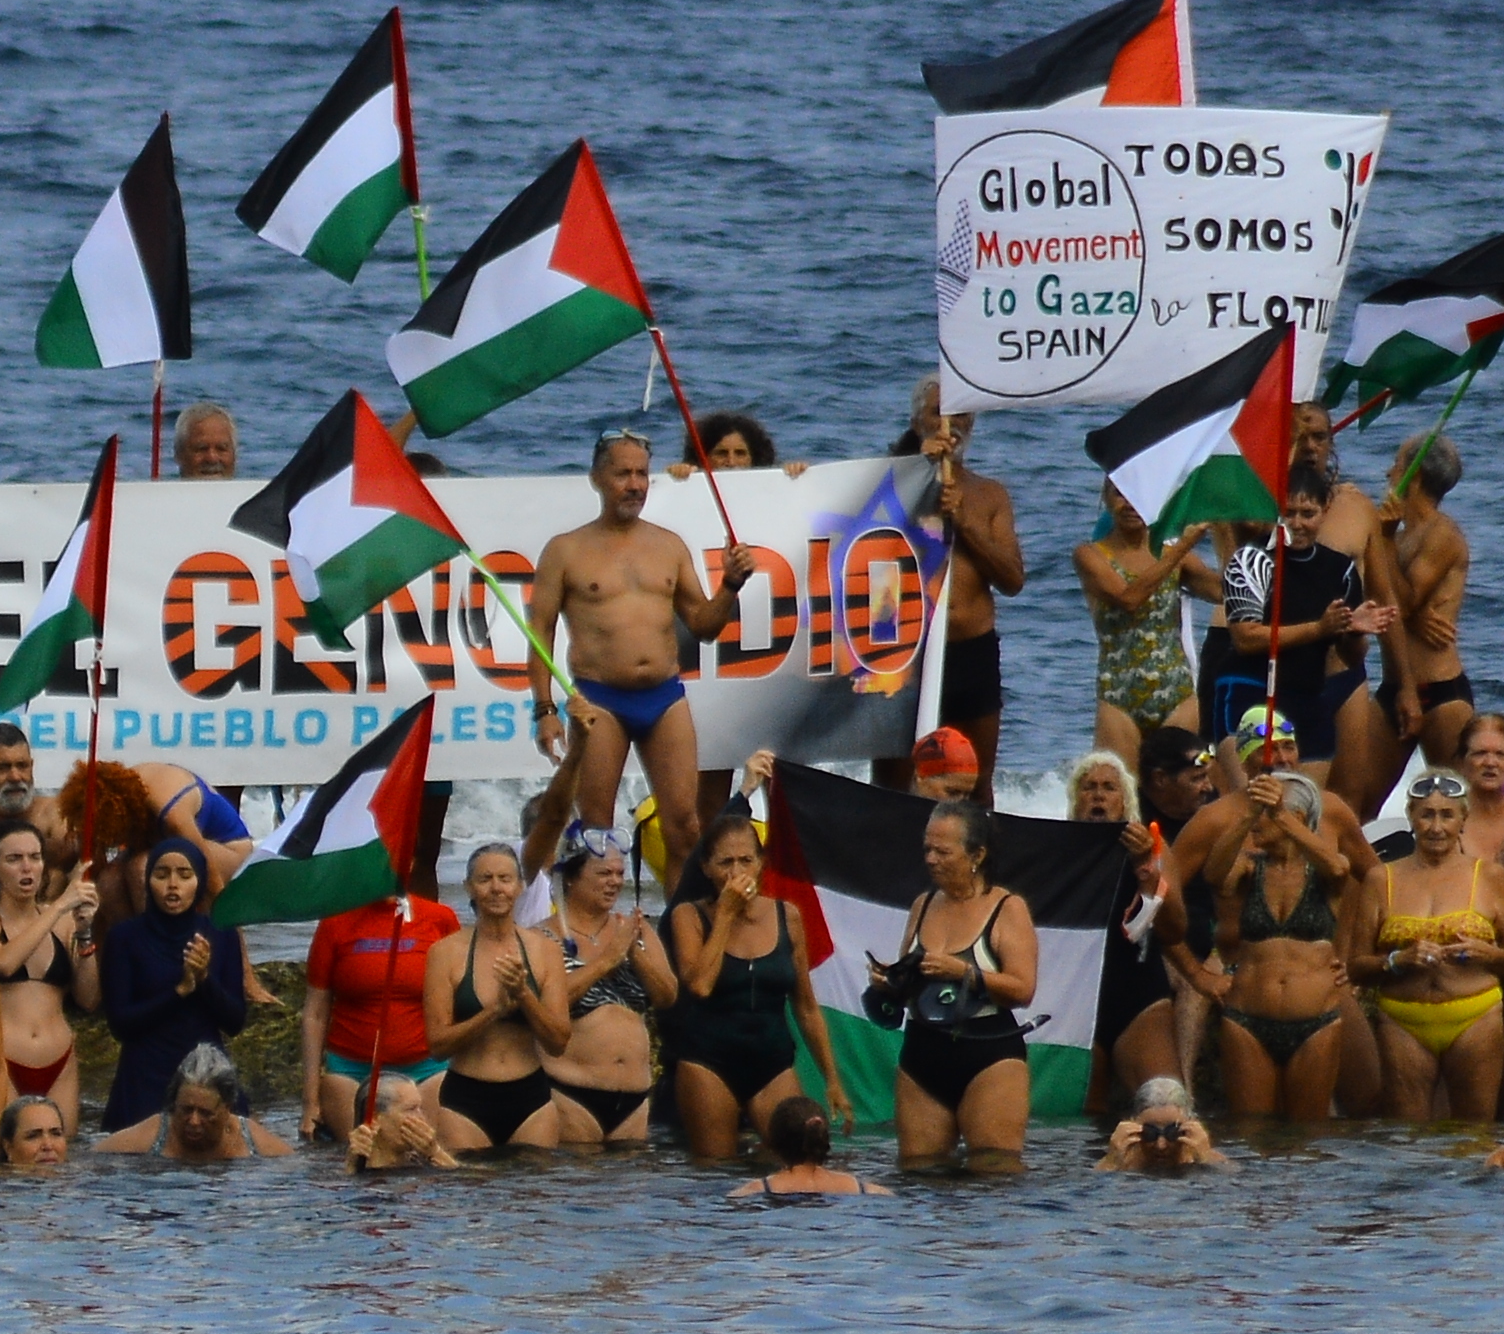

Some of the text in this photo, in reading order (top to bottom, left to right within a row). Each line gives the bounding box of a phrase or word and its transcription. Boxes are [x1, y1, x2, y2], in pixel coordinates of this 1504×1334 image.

[978, 161, 1111, 213] Global
[976, 229, 1143, 270] Movement
[1163, 216, 1313, 253] SOMOS
[982, 274, 1137, 318] to Gaza
[1150, 298, 1191, 327] la
[998, 326, 1107, 362] SPAIN
[113, 709, 329, 751] PUEBLO
